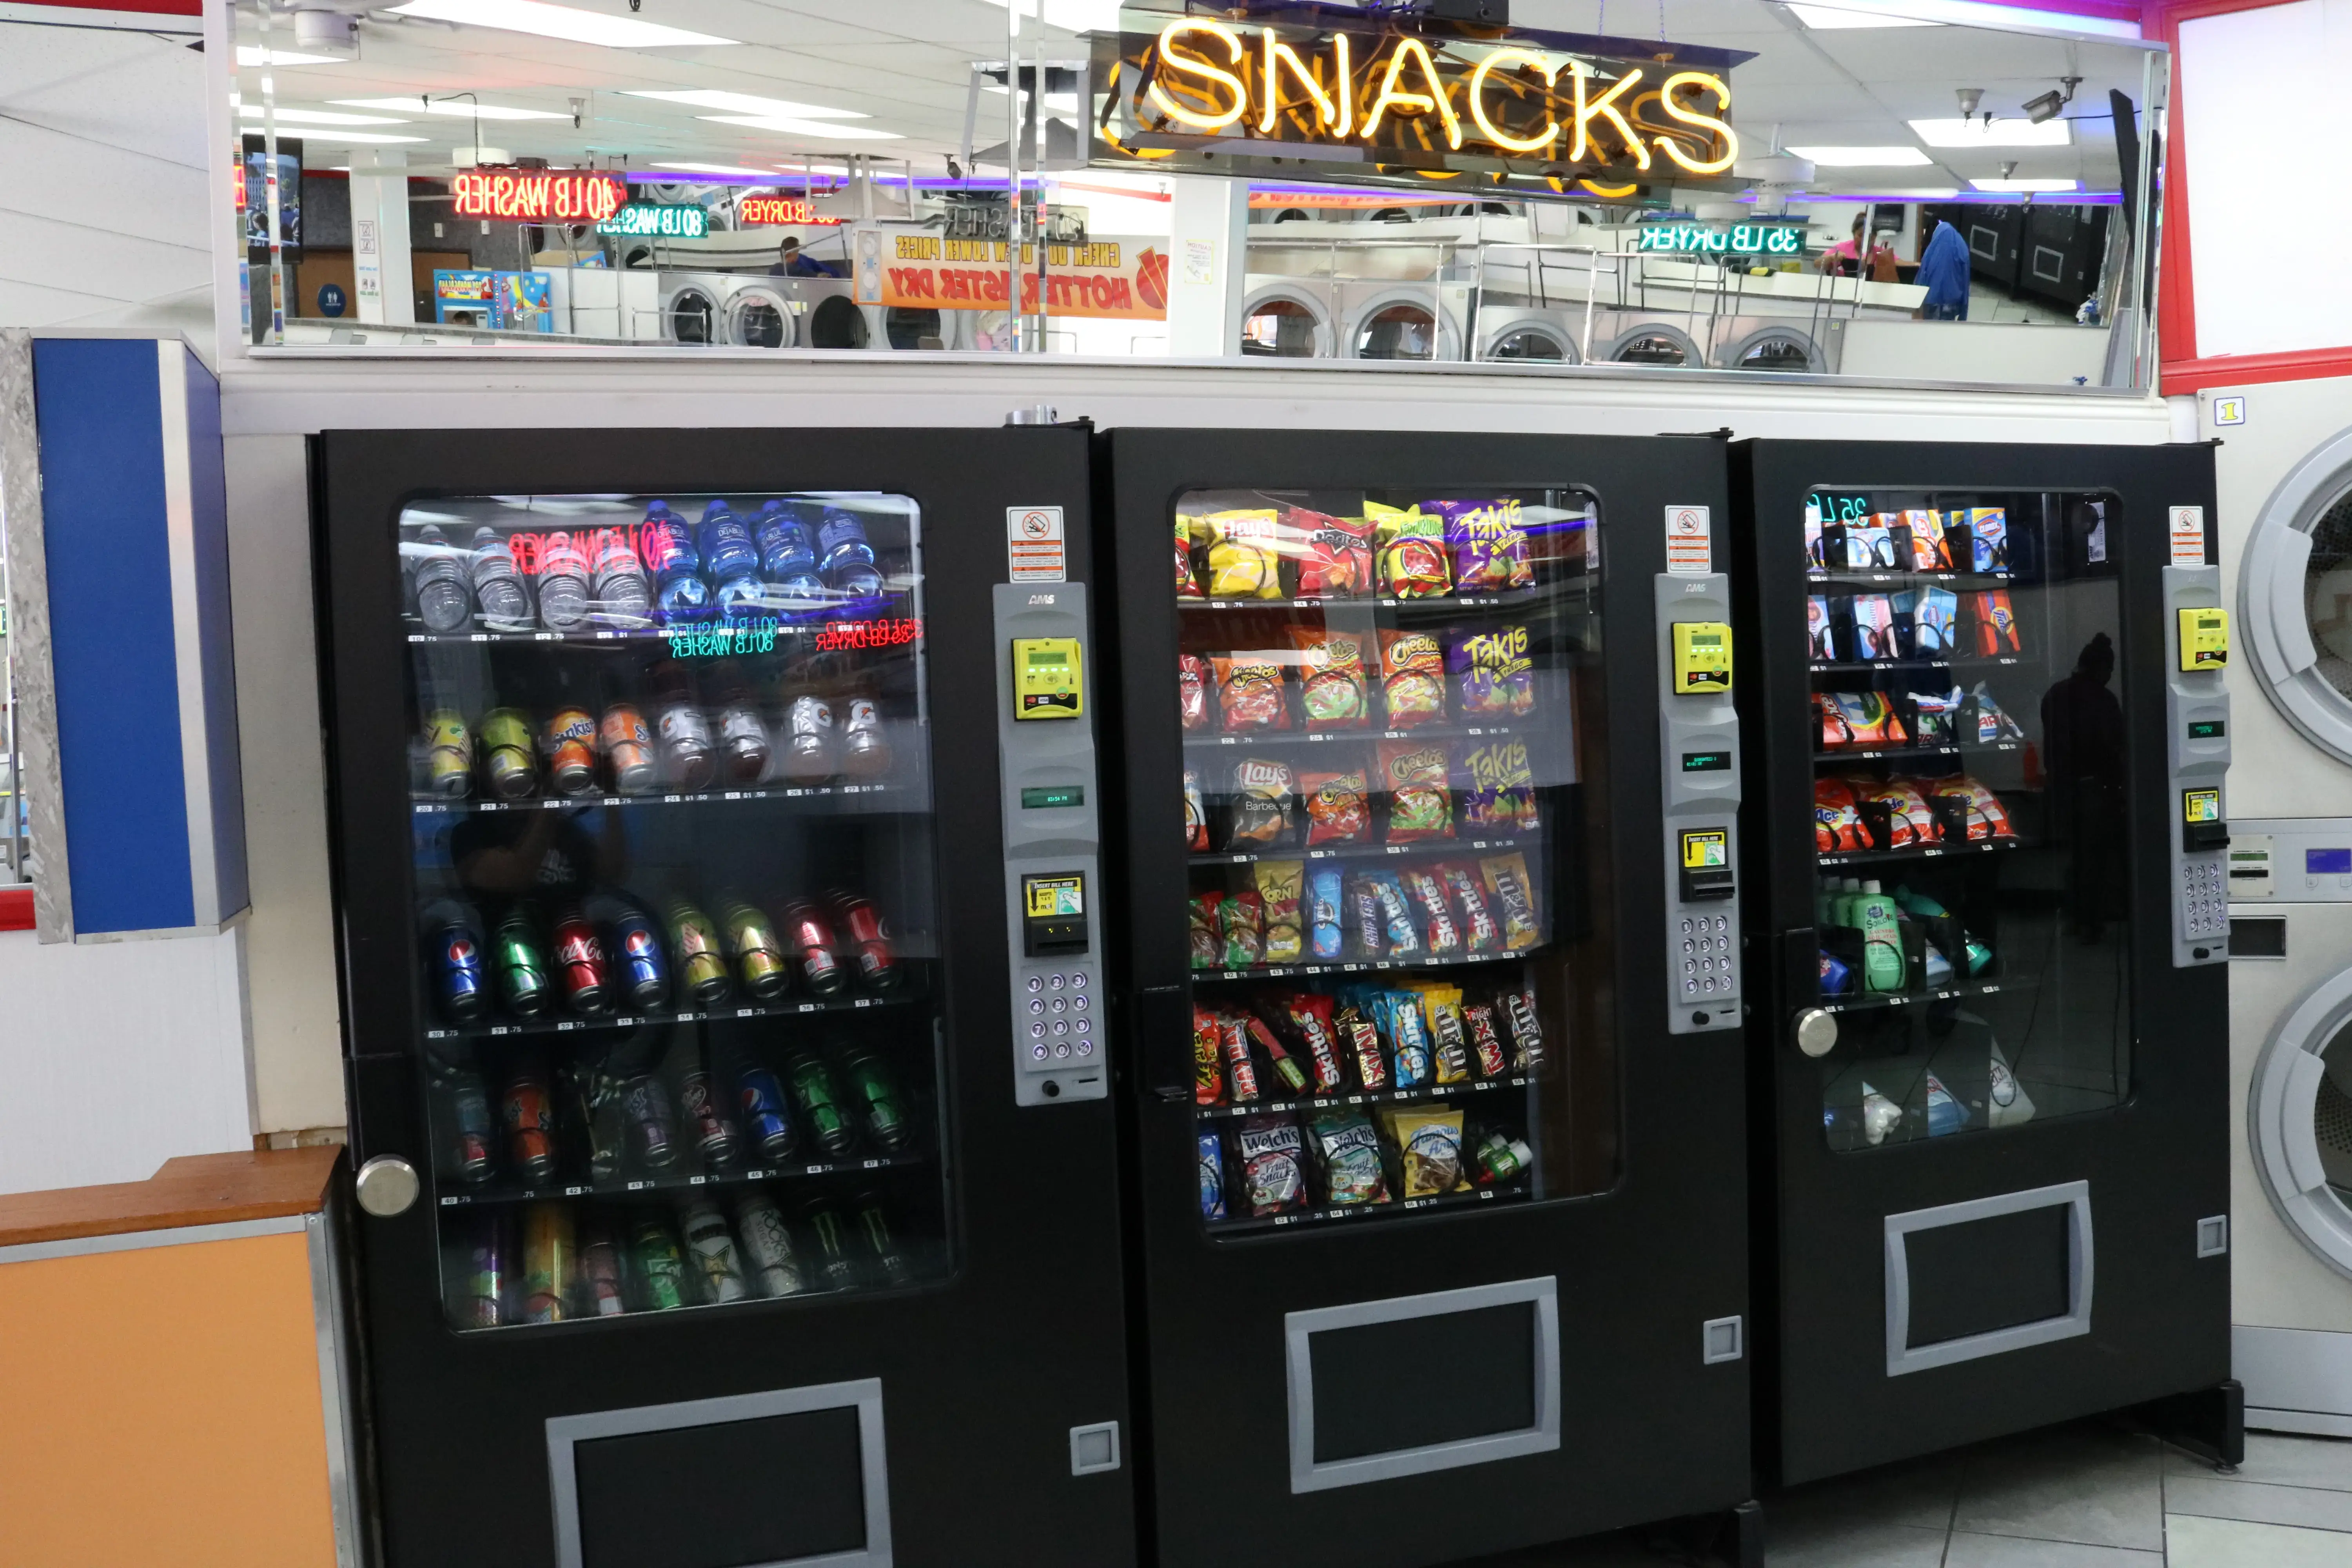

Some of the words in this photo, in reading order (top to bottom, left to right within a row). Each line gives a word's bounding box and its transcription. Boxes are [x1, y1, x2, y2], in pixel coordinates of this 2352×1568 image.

[1149, 17, 1740, 174] SNACKS
[2221, 402, 2238, 421] 1
[1313, 528, 1367, 548] Doritos
[1686, 583, 1706, 593] AMS
[1028, 594, 1055, 605] AMS
[1391, 749, 1445, 781] Cheetos
[1245, 801, 1292, 811] Barbecue
[1815, 808, 1840, 821] Ace
[1261, 885, 1293, 904] CORN
[1471, 1007, 1492, 1021] RIGHT
[1301, 1011, 1341, 1086] Skittles
[1244, 1129, 1299, 1153] Welch's
[1410, 1124, 1459, 1150] Famous
[1265, 1158, 1291, 1174] Fruit
[1259, 1167, 1297, 1186] Snacks
